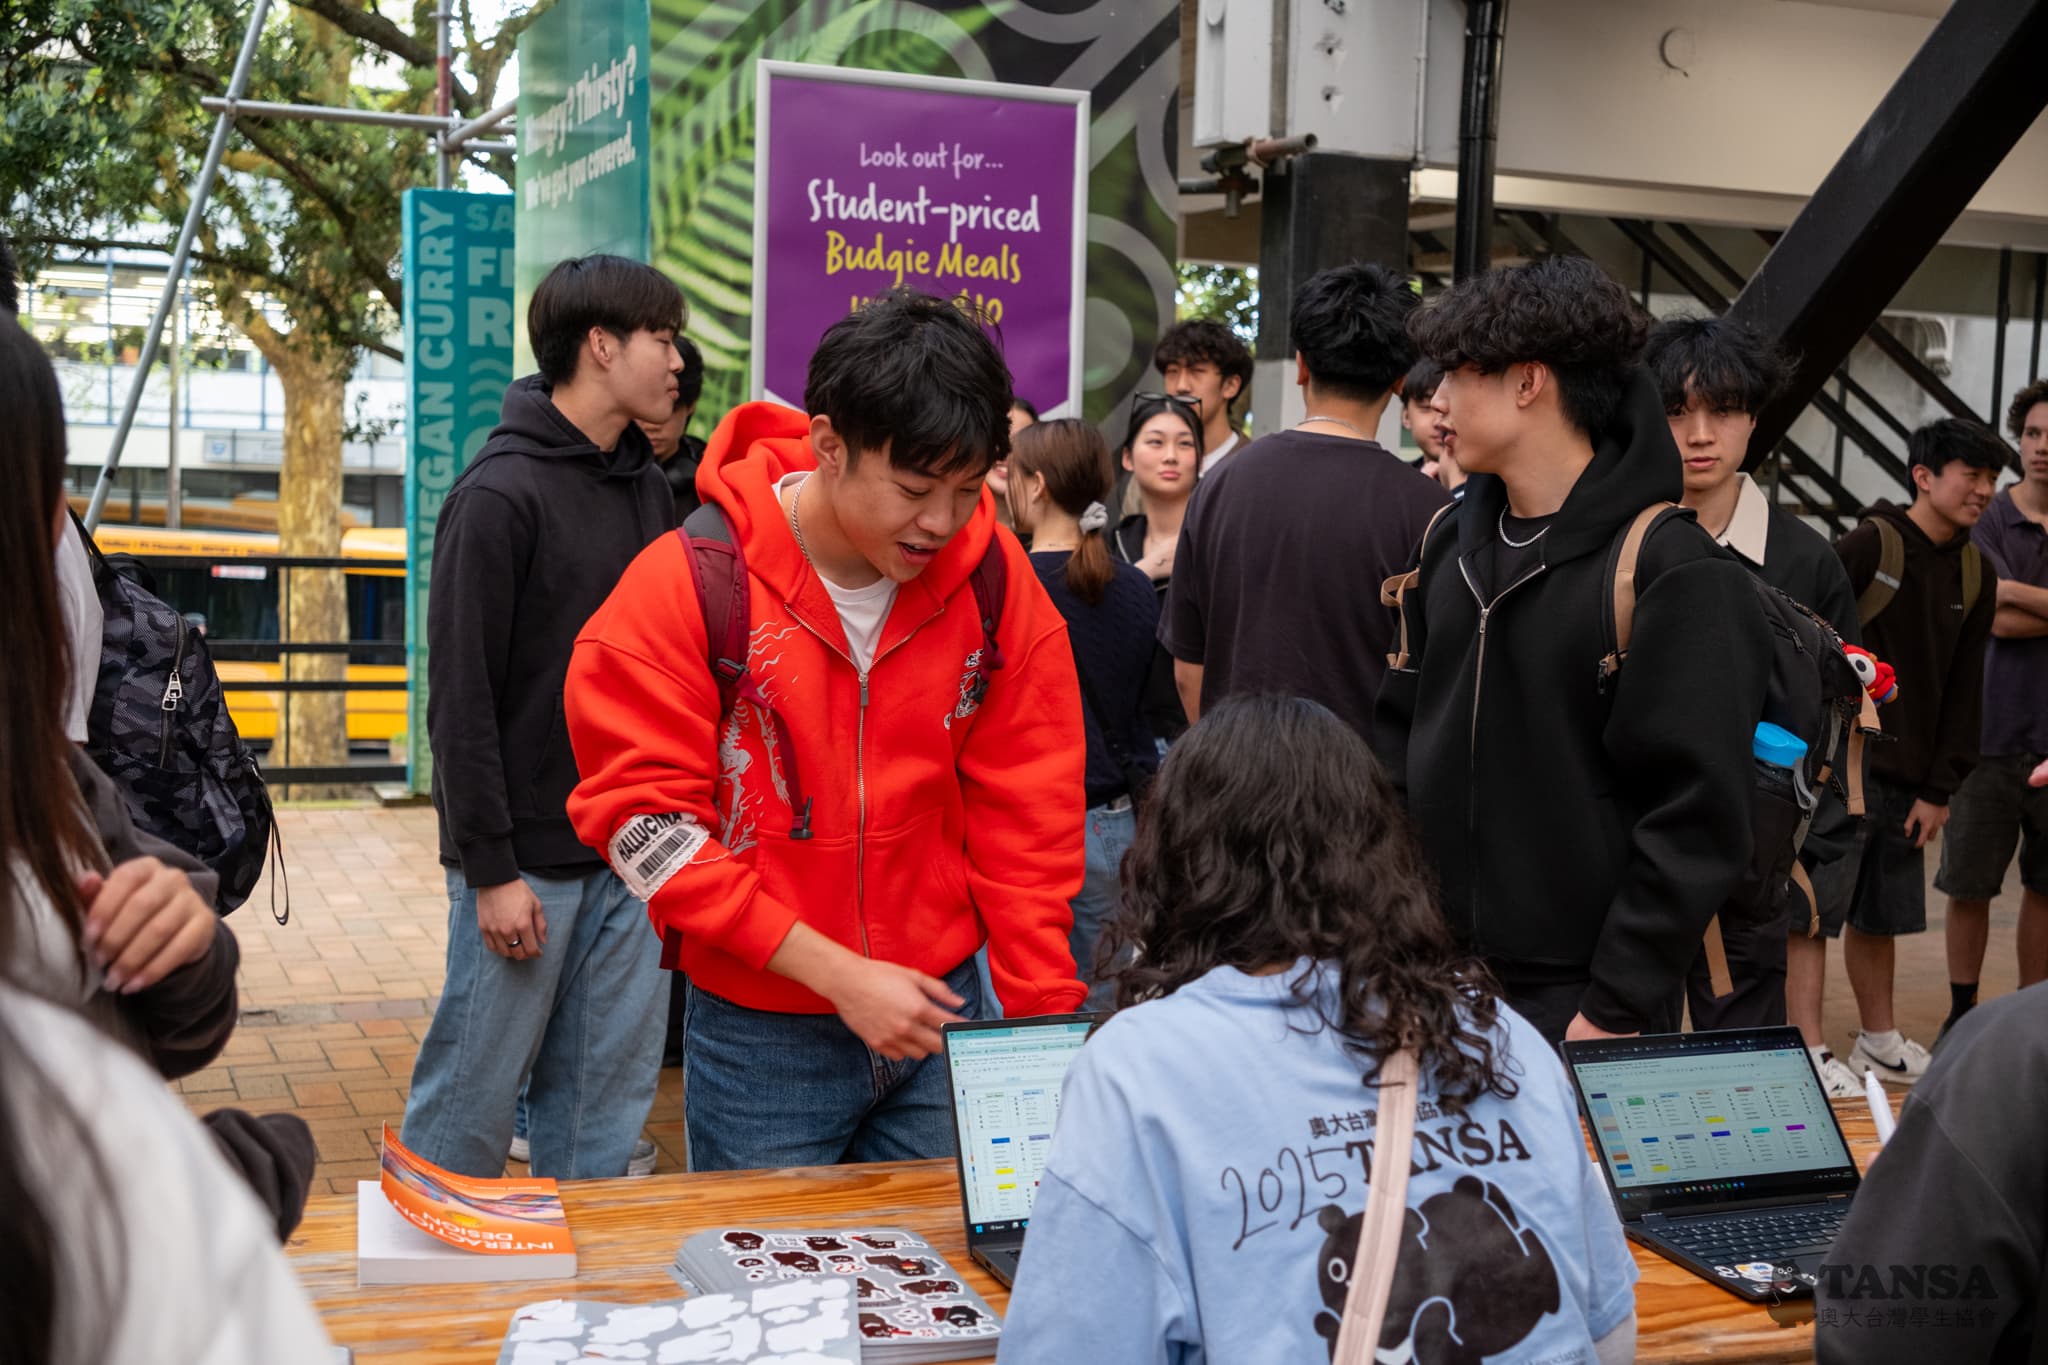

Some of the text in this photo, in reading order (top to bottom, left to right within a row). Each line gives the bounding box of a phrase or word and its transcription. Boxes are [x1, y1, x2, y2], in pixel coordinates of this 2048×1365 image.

[575, 44, 637, 125] Thirsty?
[568, 156, 587, 203] you
[587, 120, 637, 181] covered.
[859, 142, 1003, 180] Look out for...
[807, 178, 1041, 244] Student-priced
[418, 201, 455, 370] CURRY
[825, 230, 1021, 290] Budgie Meals
[1346, 1118, 1531, 1184] TNSA
[393, 1199, 554, 1250] INTERACTION
[423, 1211, 513, 1241] DESIGN
[1221, 1145, 1347, 1251] 2025
